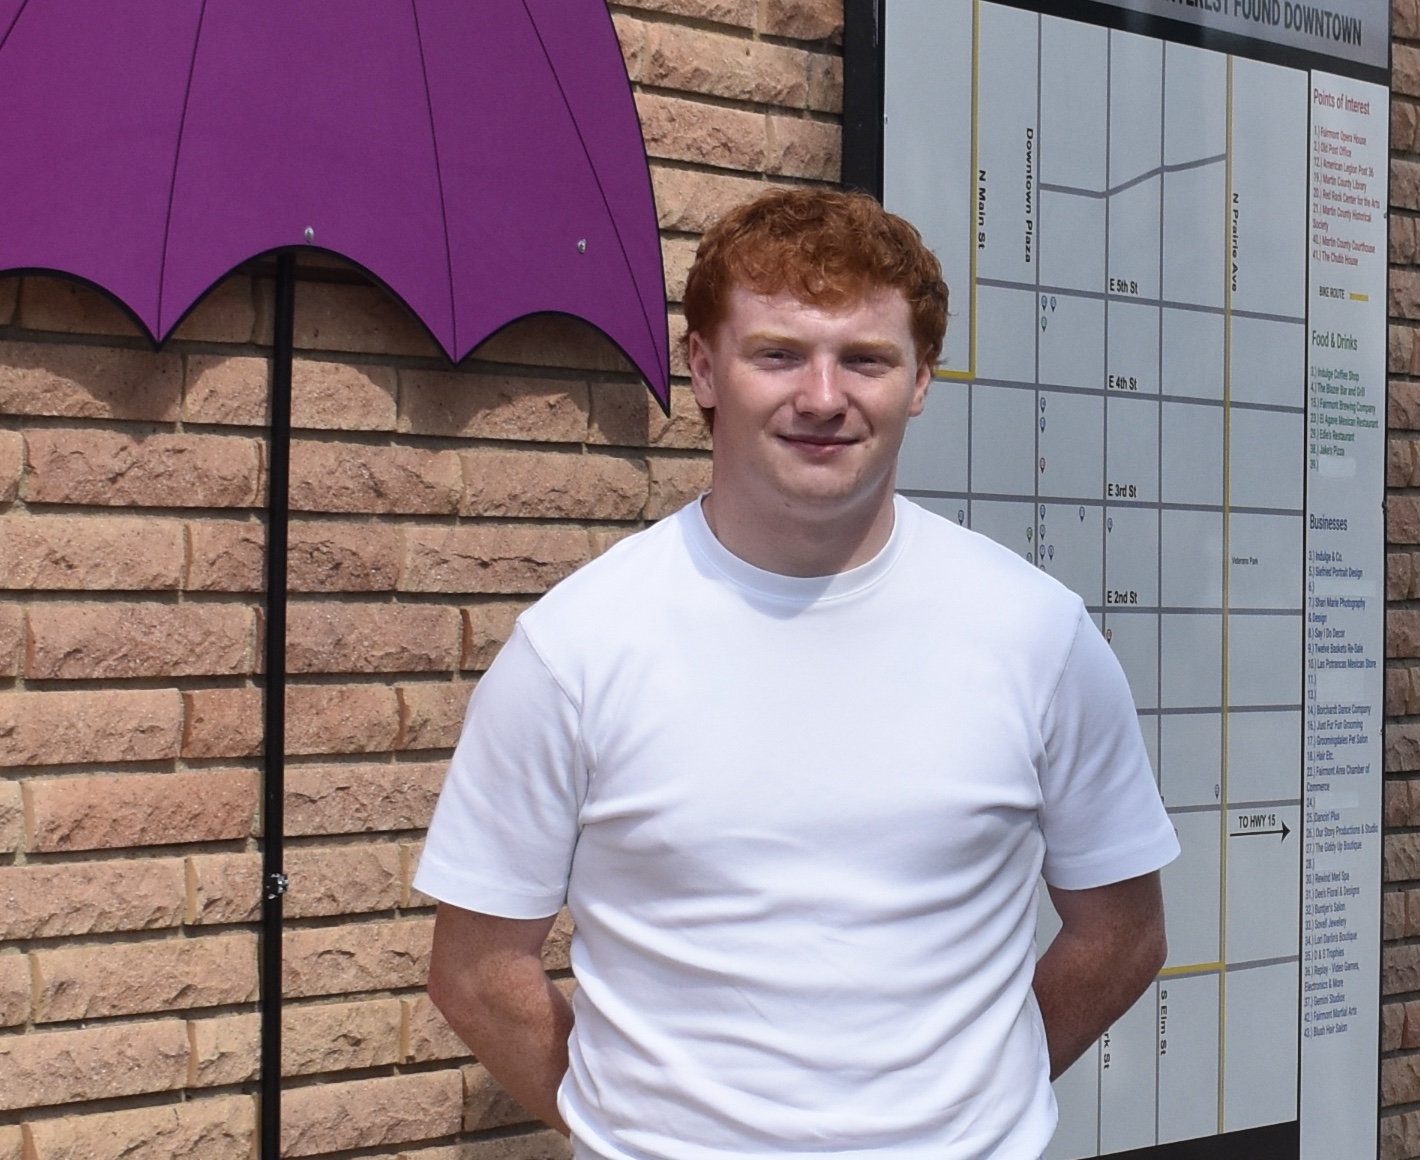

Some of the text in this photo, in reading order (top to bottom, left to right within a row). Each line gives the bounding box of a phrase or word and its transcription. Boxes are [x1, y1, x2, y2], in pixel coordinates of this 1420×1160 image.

[1234, 0, 1280, 26] FOUND
[1285, 1, 1362, 47] DOWNTOWN
[1313, 88, 1370, 116] Points of Interest
[1024, 127, 1034, 263] Downtown Plaza
[1232, 193, 1239, 204] N
[978, 169, 986, 250] N Main St
[1231, 262, 1239, 292] Ave
[1110, 278, 1138, 295] E 5th St
[1319, 286, 1345, 300] BIKE ROUTE
[1312, 330, 1358, 351] Food & Drinks
[1109, 375, 1137, 391] E 4th St
[1108, 483, 1137, 499] E 3rd St
[1310, 513, 1348, 531] Businesses
[1107, 590, 1138, 605] E 2nd St
[1238, 813, 1276, 829] TO HWY 15
[1160, 989, 1168, 1056] S Elm St
[1104, 1053, 1111, 1070] St
